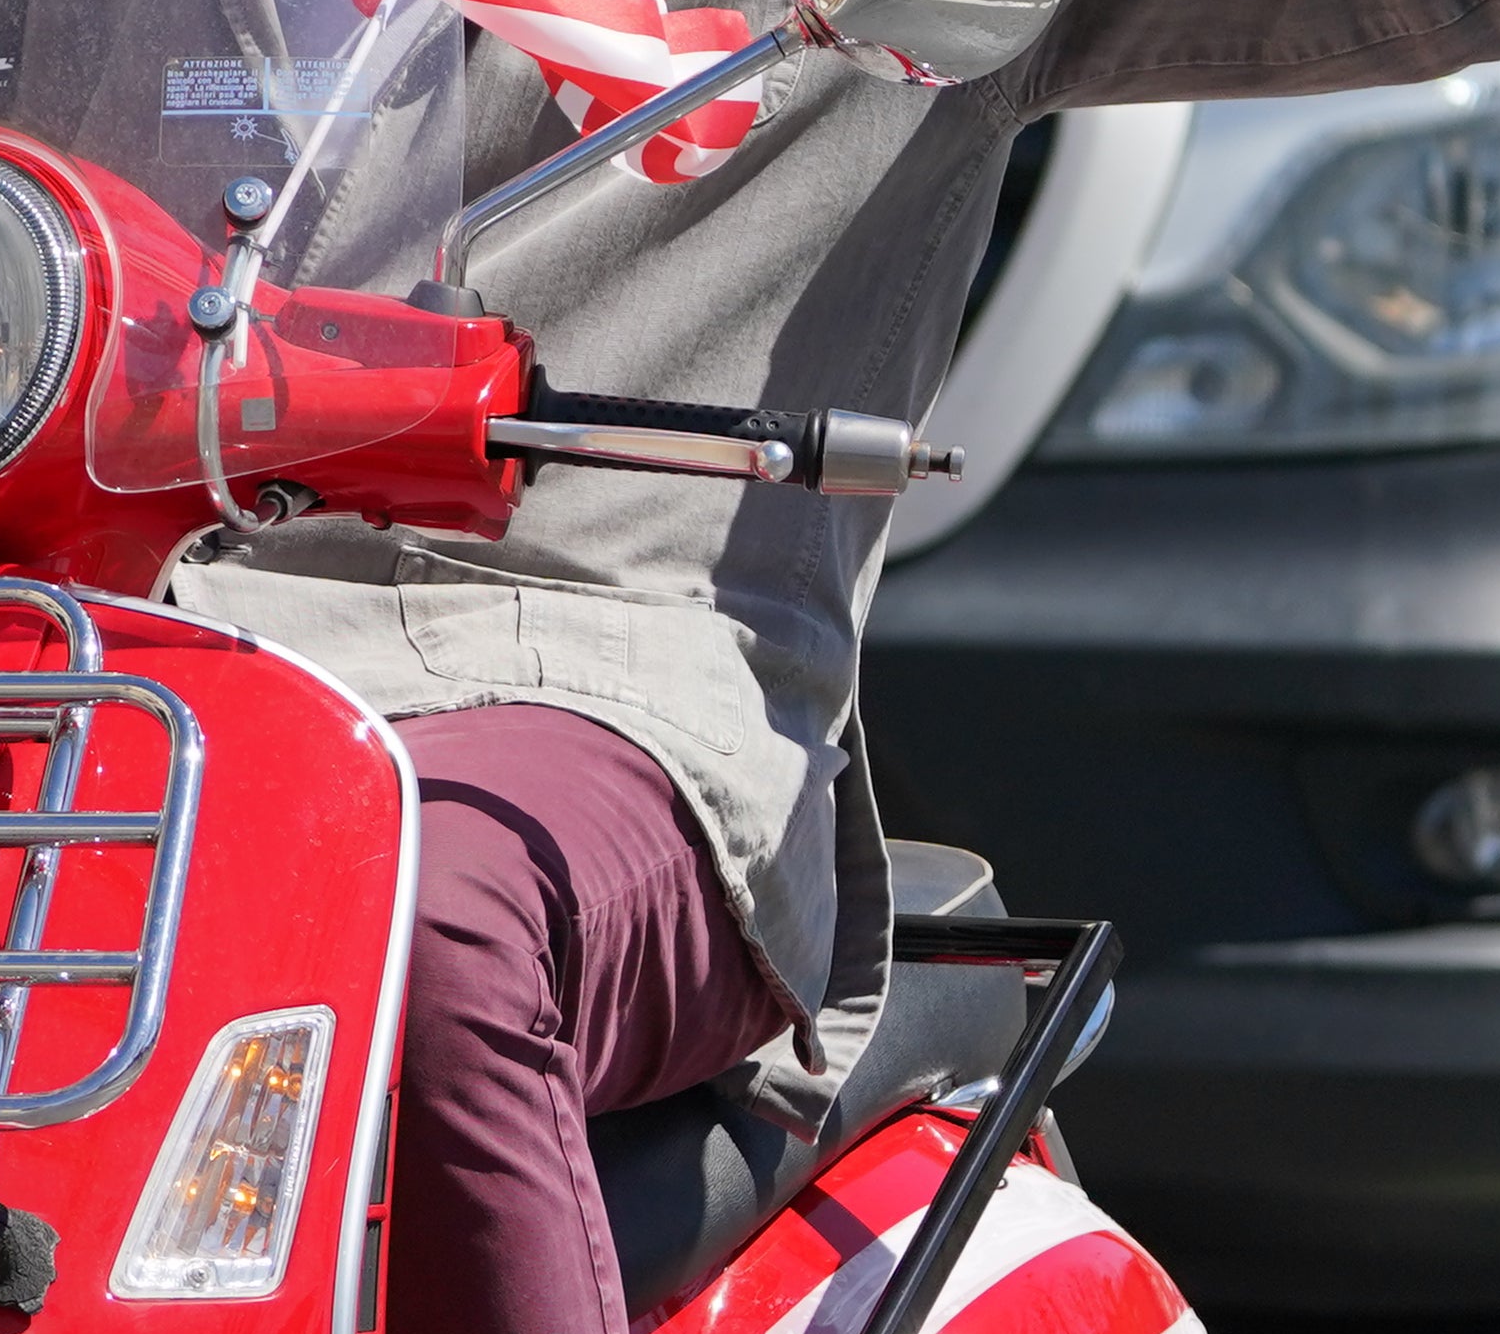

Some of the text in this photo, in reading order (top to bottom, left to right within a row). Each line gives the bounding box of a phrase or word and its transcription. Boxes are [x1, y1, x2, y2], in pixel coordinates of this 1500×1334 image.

[183, 59, 243, 68] ATTENZIONE
[167, 69, 184, 78] Non
[189, 69, 247, 78] parcheggiare
[167, 77, 196, 85] veicolo
[197, 77, 212, 85] con
[166, 92, 189, 100] raggi
[191, 92, 216, 100] solari
